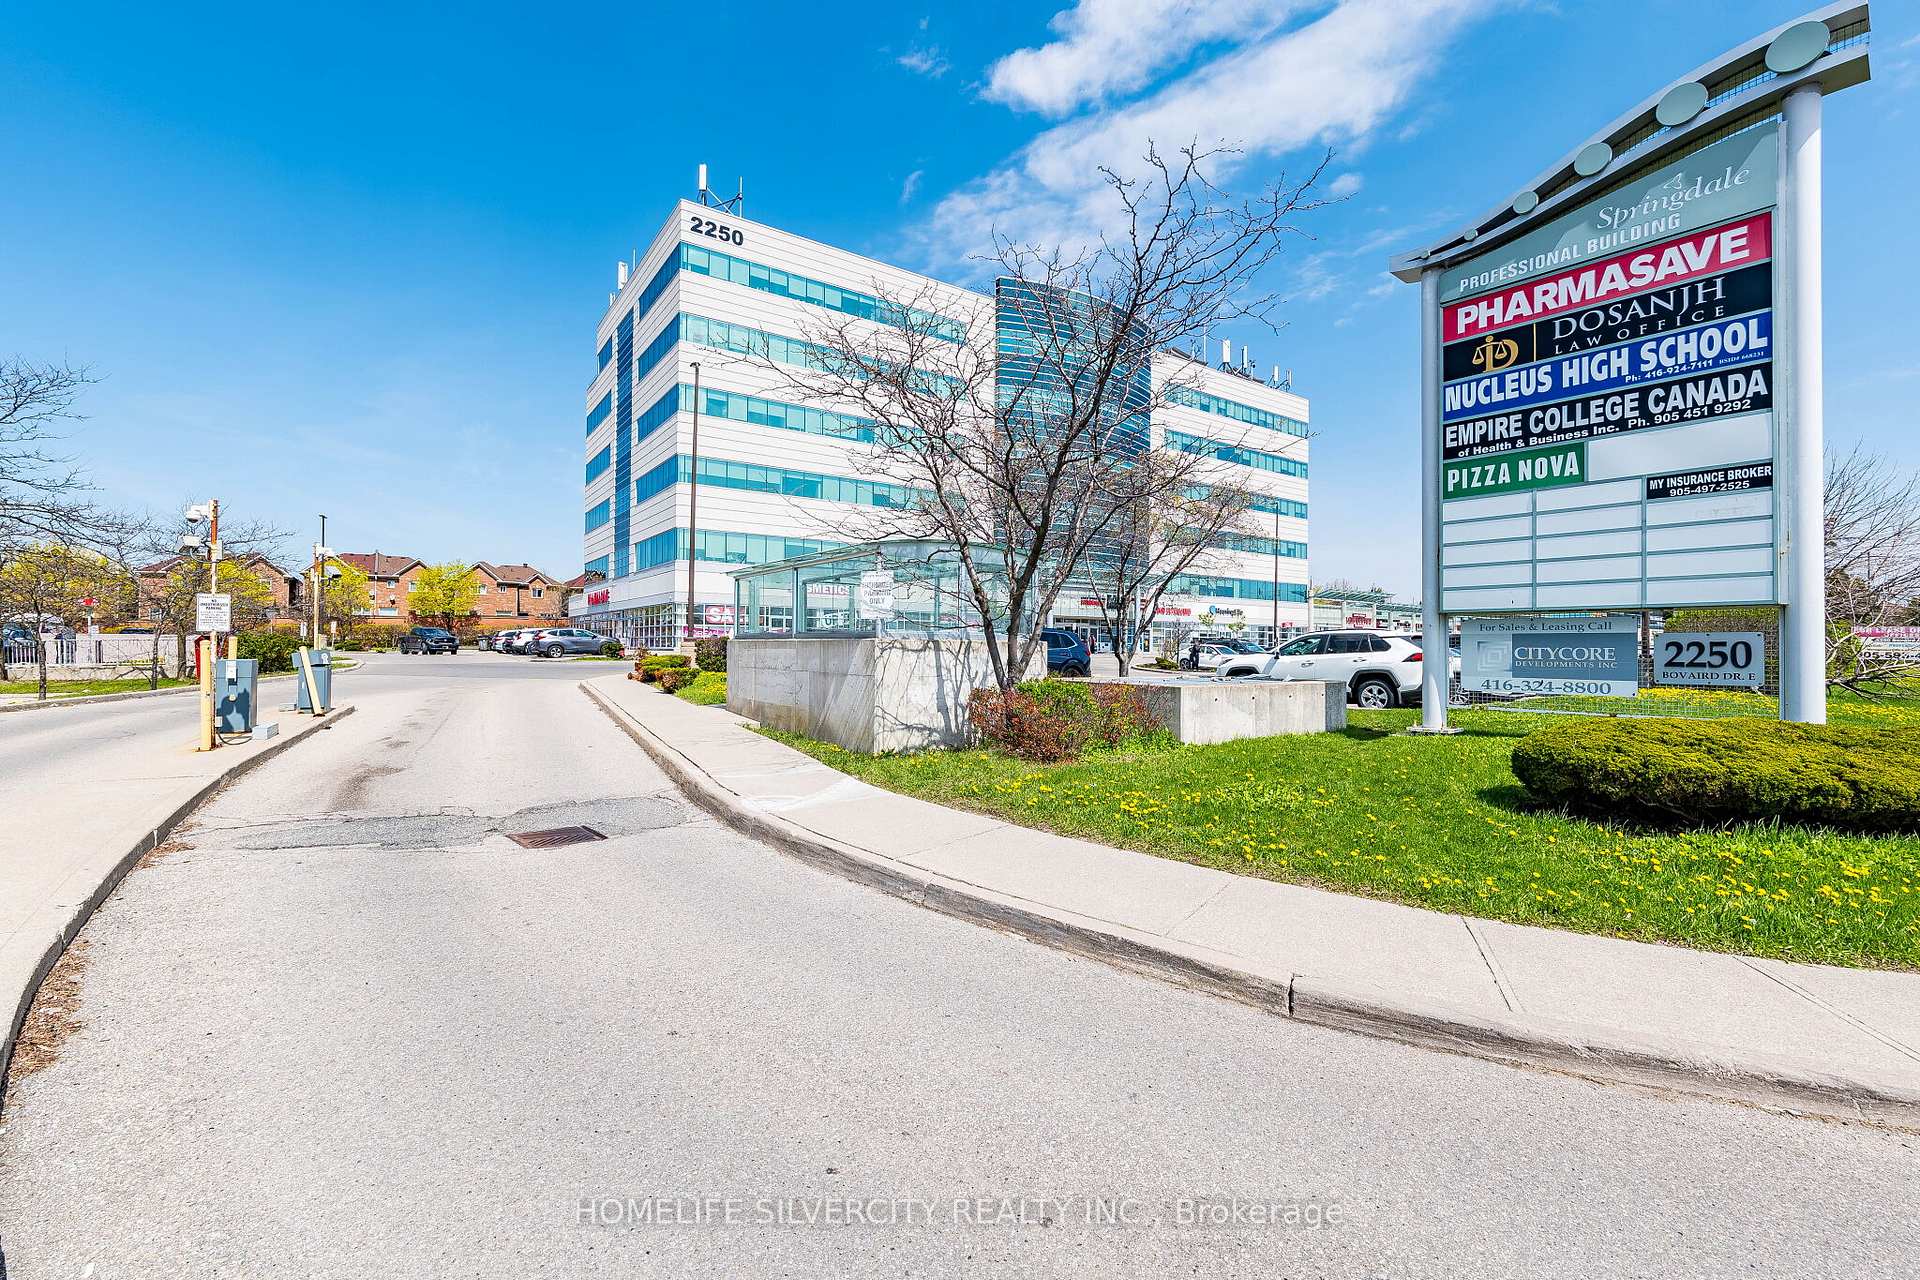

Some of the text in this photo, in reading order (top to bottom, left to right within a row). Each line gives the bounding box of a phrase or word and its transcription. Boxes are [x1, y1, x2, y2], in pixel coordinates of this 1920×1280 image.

[1597, 166, 1750, 229] Springdale
[690, 216, 744, 246] 2250
[1460, 213, 1681, 292] PROFESSIONAL BUILDING
[1457, 225, 1750, 335] PHARMASAVE
[1552, 277, 1727, 340] DOSANJH
[1555, 305, 1725, 355] LAW OFFICE
[1445, 318, 1768, 412] NUCLEUS HIGH SCHOOL
[1625, 359, 1713, 383] Ph: 416-924-7111
[1445, 369, 1768, 448] EMPIRE COLLEGE CANADA
[1458, 400, 1751, 458] of Health & Business Inc. Ph. 905 451 9292
[1447, 451, 1580, 492] PIZZA NOVA
[1649, 465, 1772, 490] MY INSURANCE BROKER
[1669, 480, 1750, 497] 905-497-2525
[1479, 620, 1612, 634] For Sales & Leasing Call
[1513, 646, 1616, 662] CITYCORE
[1515, 660, 1618, 669] DEVELOPMENTS INC
[1663, 640, 1753, 669] 2250
[1480, 678, 1612, 695] 416-324-8800
[1662, 671, 1756, 681] BOVAIRD DR. E
